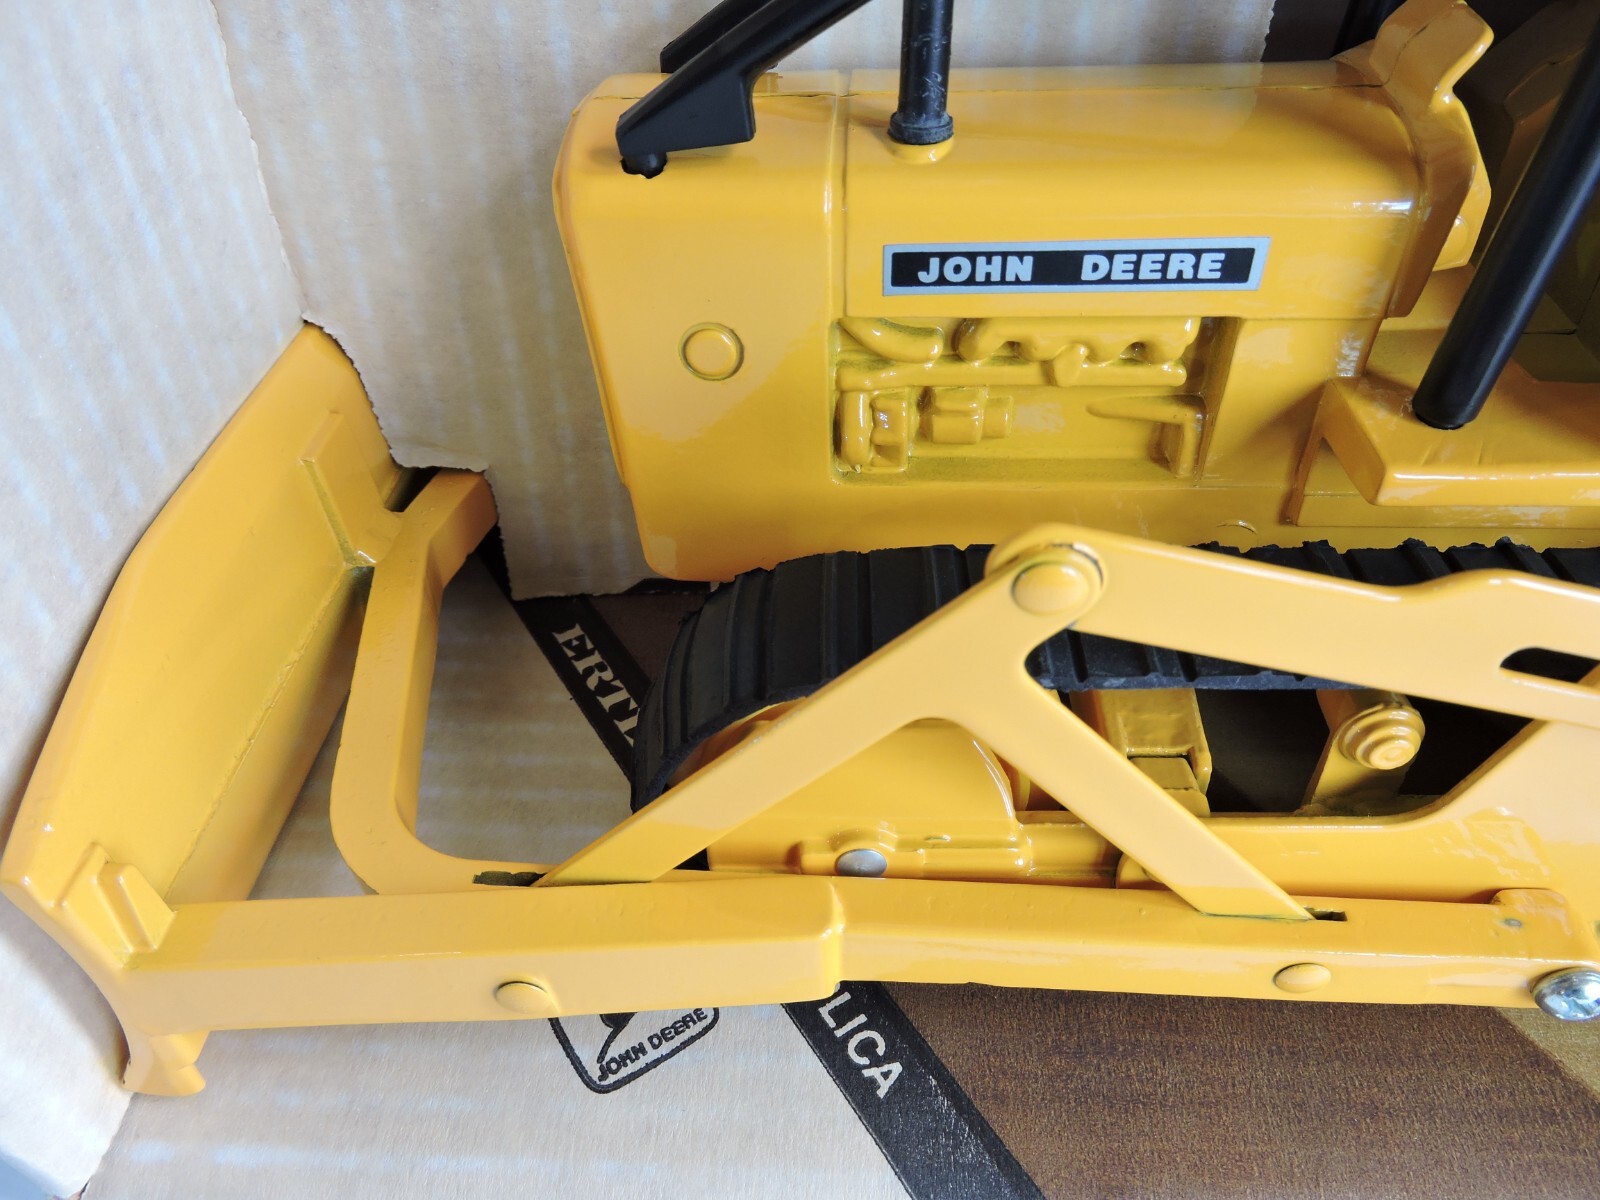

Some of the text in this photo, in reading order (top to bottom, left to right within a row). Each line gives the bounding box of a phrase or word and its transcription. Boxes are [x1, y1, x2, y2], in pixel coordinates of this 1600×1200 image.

[917, 252, 1226, 284] JOHN DEERE
[597, 1007, 709, 1082] JOHN DEERE
[817, 982, 903, 1100] LICA
